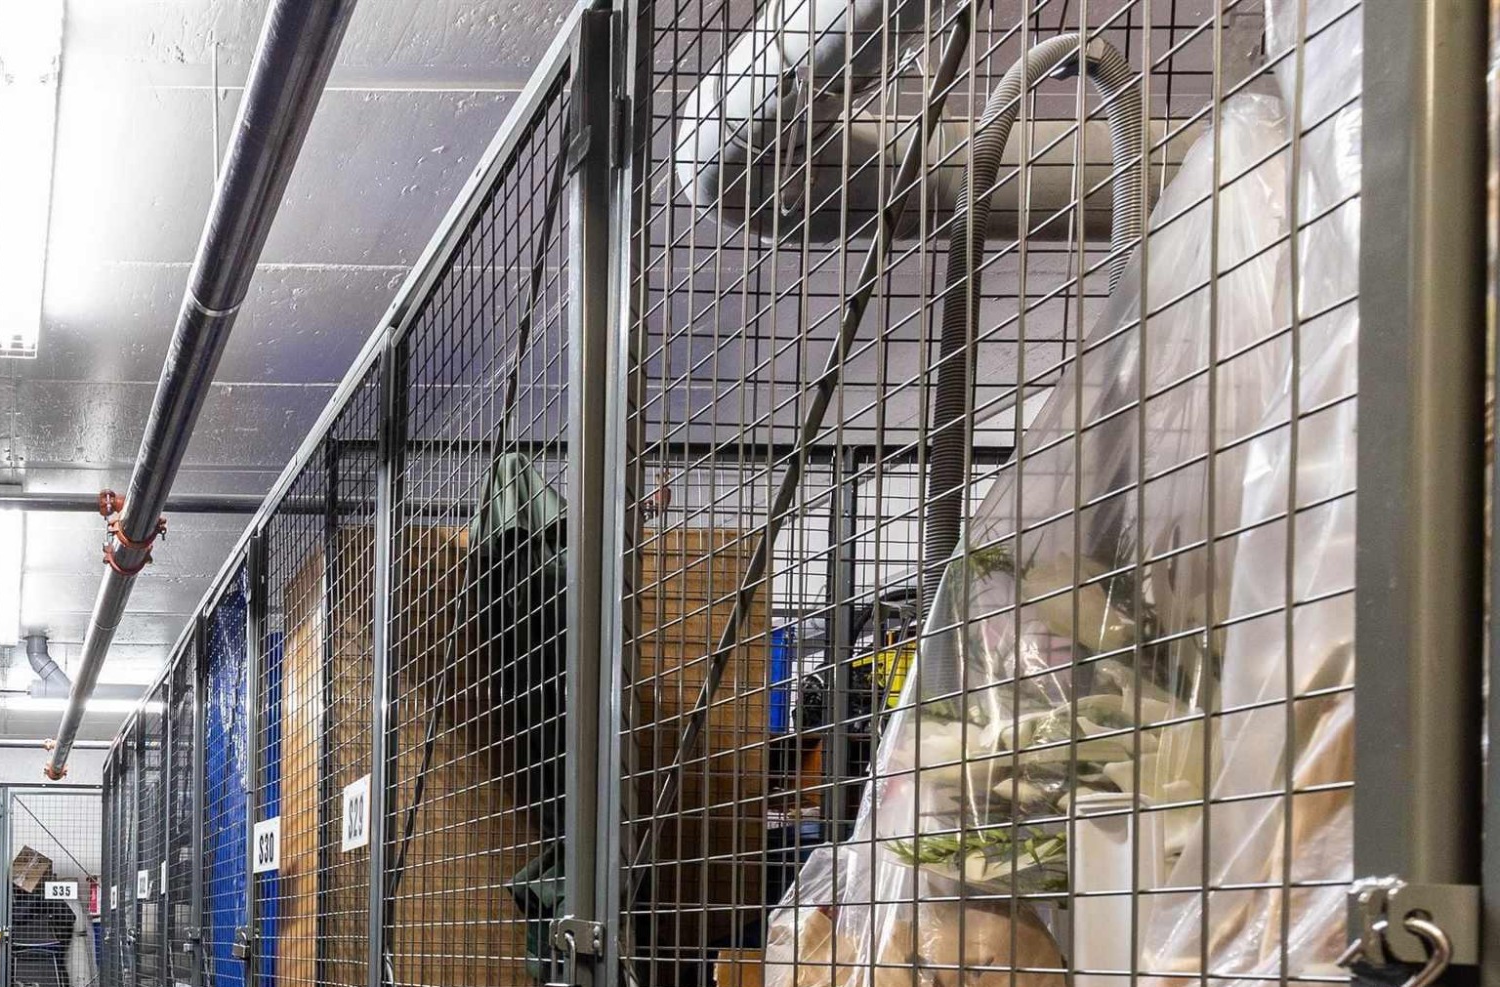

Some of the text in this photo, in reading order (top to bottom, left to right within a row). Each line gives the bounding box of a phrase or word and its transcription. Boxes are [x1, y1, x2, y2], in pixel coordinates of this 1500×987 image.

[348, 794, 364, 840] S29
[258, 831, 275, 865] S30
[52, 885, 71, 897] S35
